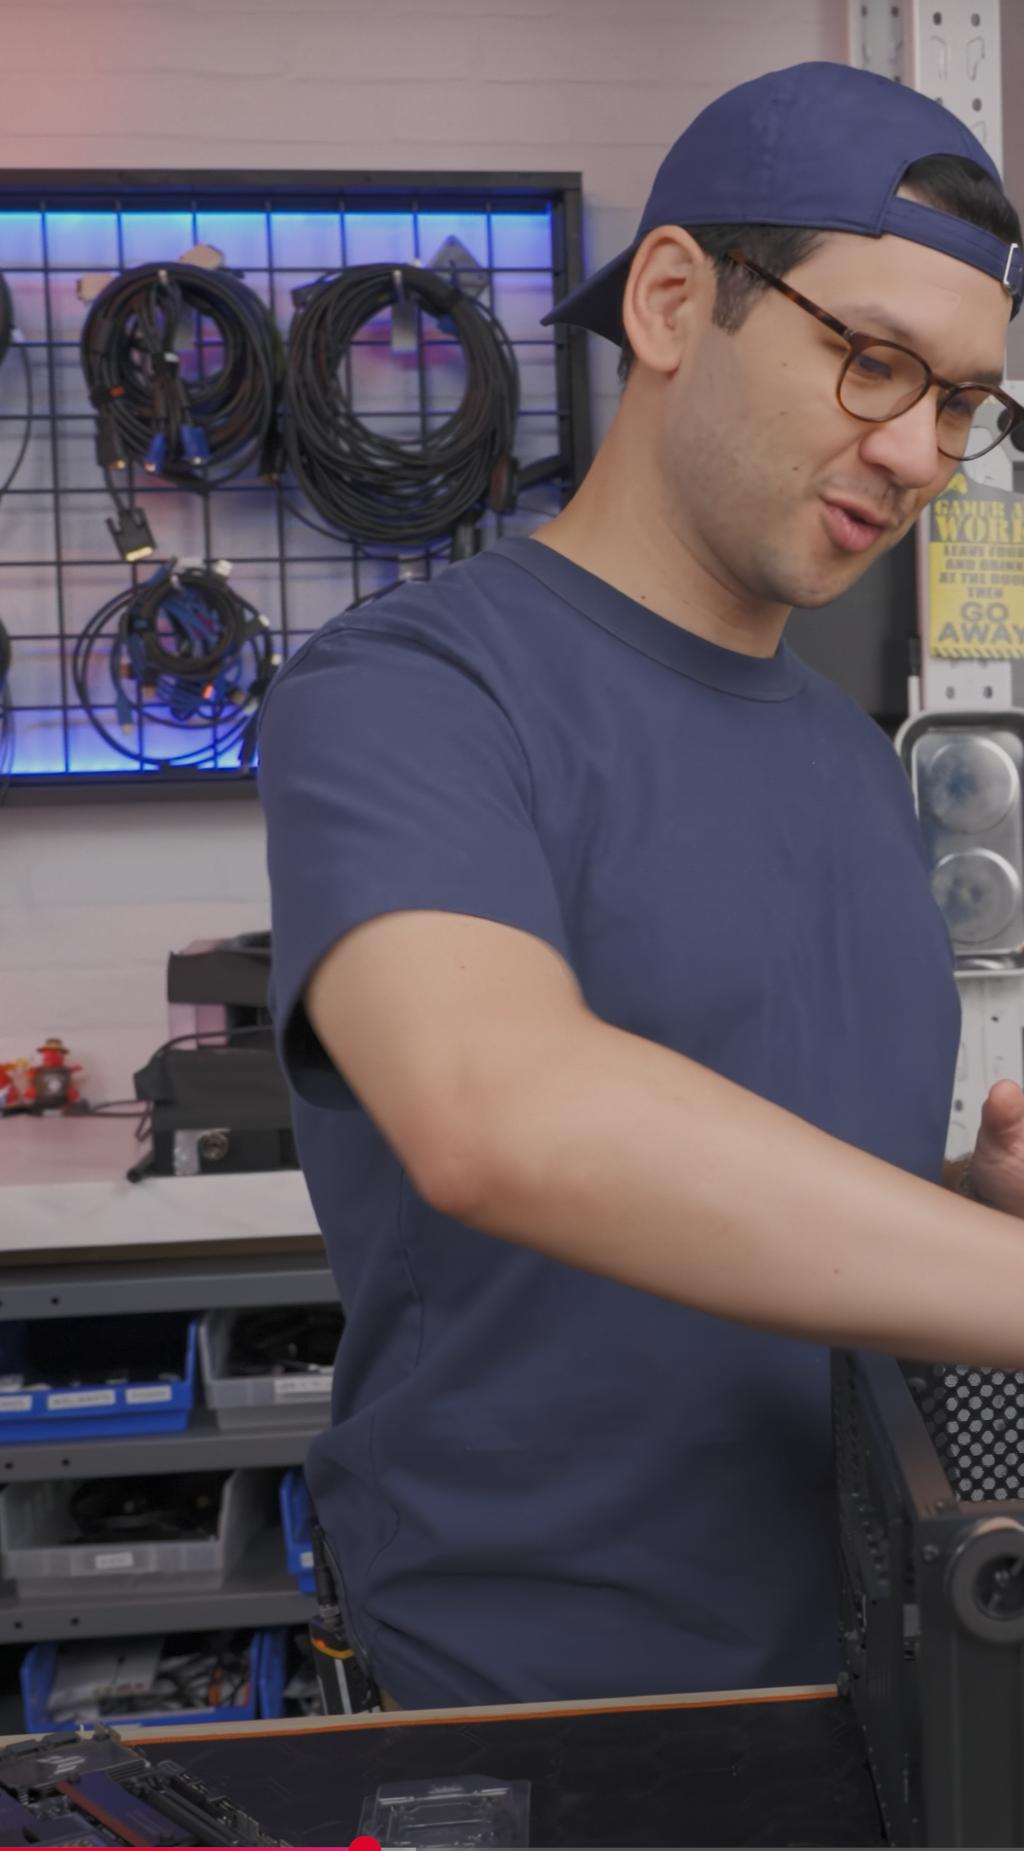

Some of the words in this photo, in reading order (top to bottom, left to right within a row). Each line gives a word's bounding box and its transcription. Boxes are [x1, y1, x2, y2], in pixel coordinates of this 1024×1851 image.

[944, 545, 985, 557] LEAVE
[945, 559, 976, 570] AND
[980, 559, 1024, 571] DRINK
[938, 572, 956, 584] AT
[960, 573, 987, 584] THE
[967, 587, 1004, 598] THEN
[960, 602, 1009, 622] GO
